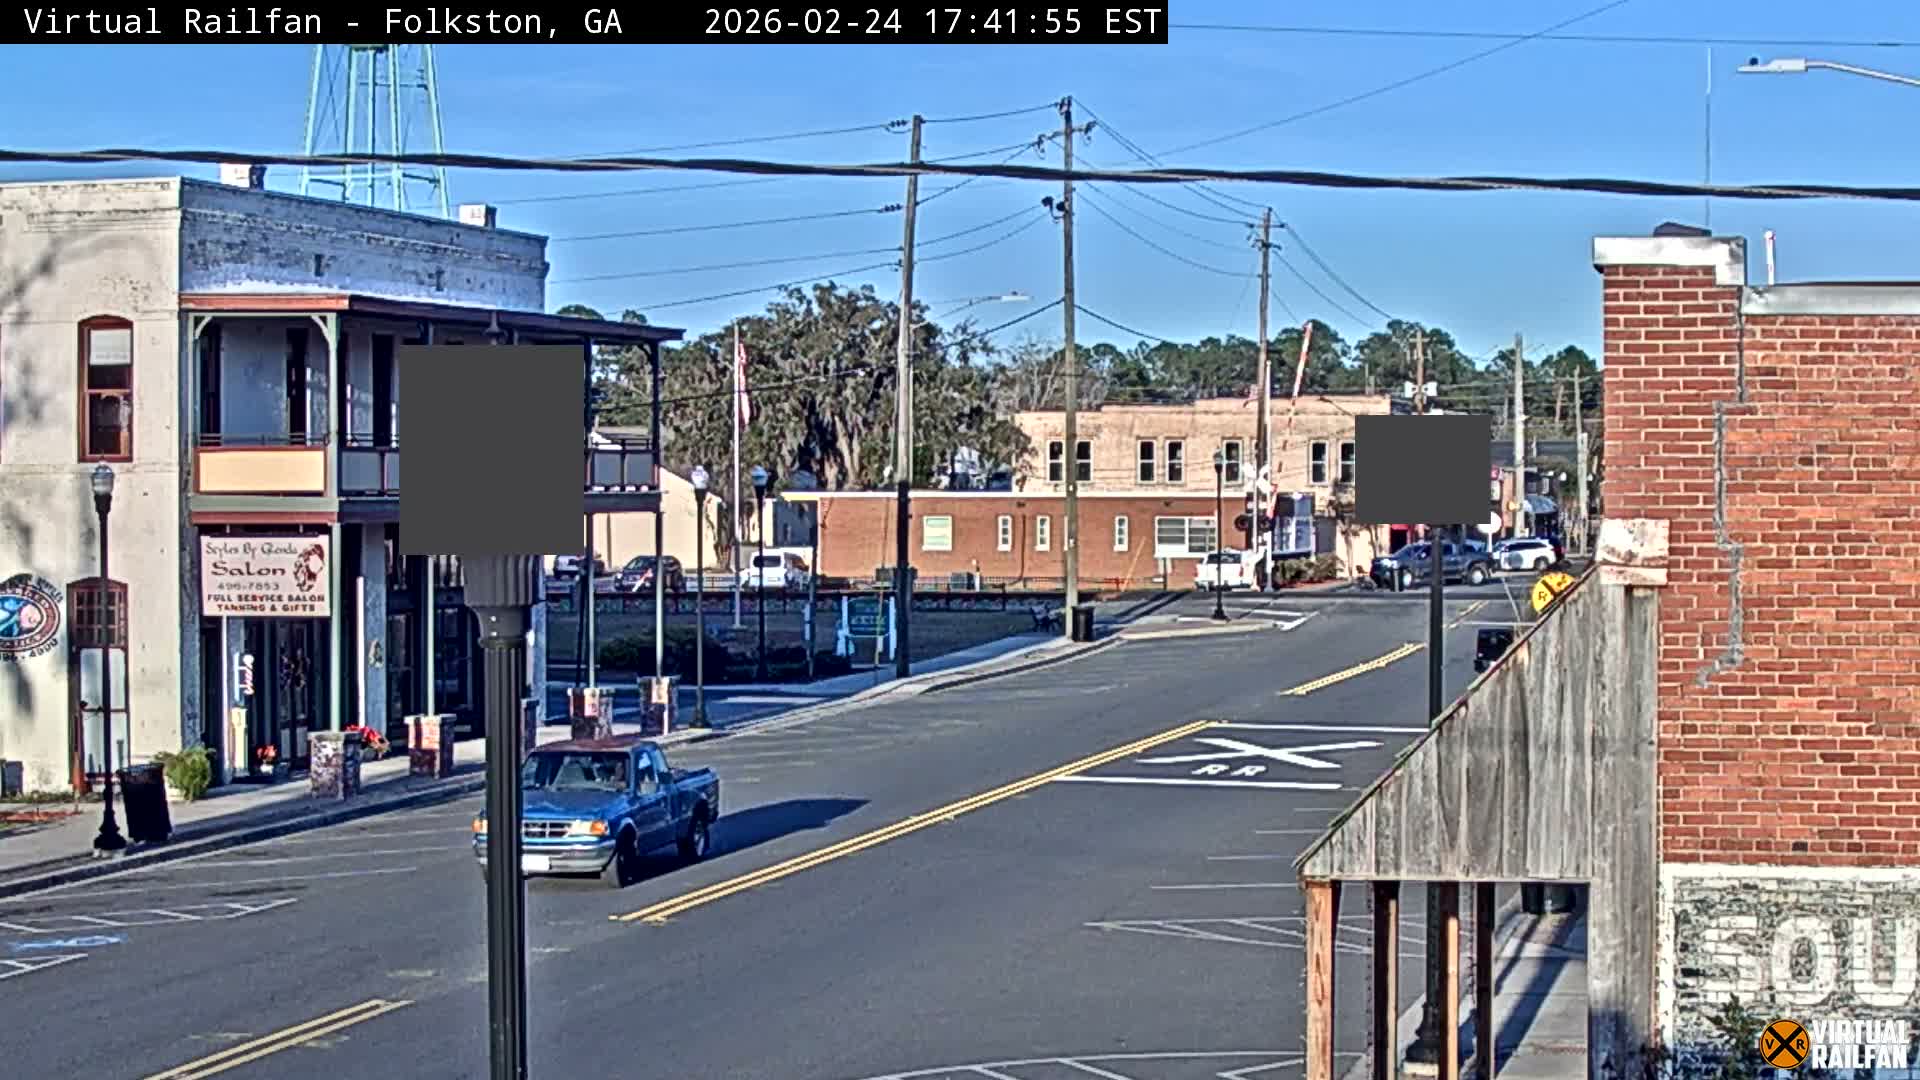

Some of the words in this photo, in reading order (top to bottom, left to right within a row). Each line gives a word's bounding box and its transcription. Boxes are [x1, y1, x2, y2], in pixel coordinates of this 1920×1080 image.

[206, 542, 239, 558] Styles
[243, 542, 256, 559] By
[211, 561, 286, 576] Salon
[207, 594, 232, 602] FULL
[238, 594, 283, 602] SERVICE
[288, 594, 325, 602] SALON
[217, 604, 265, 612] TANNING
[270, 604, 277, 612] &
[282, 604, 315, 612] GIFTS
